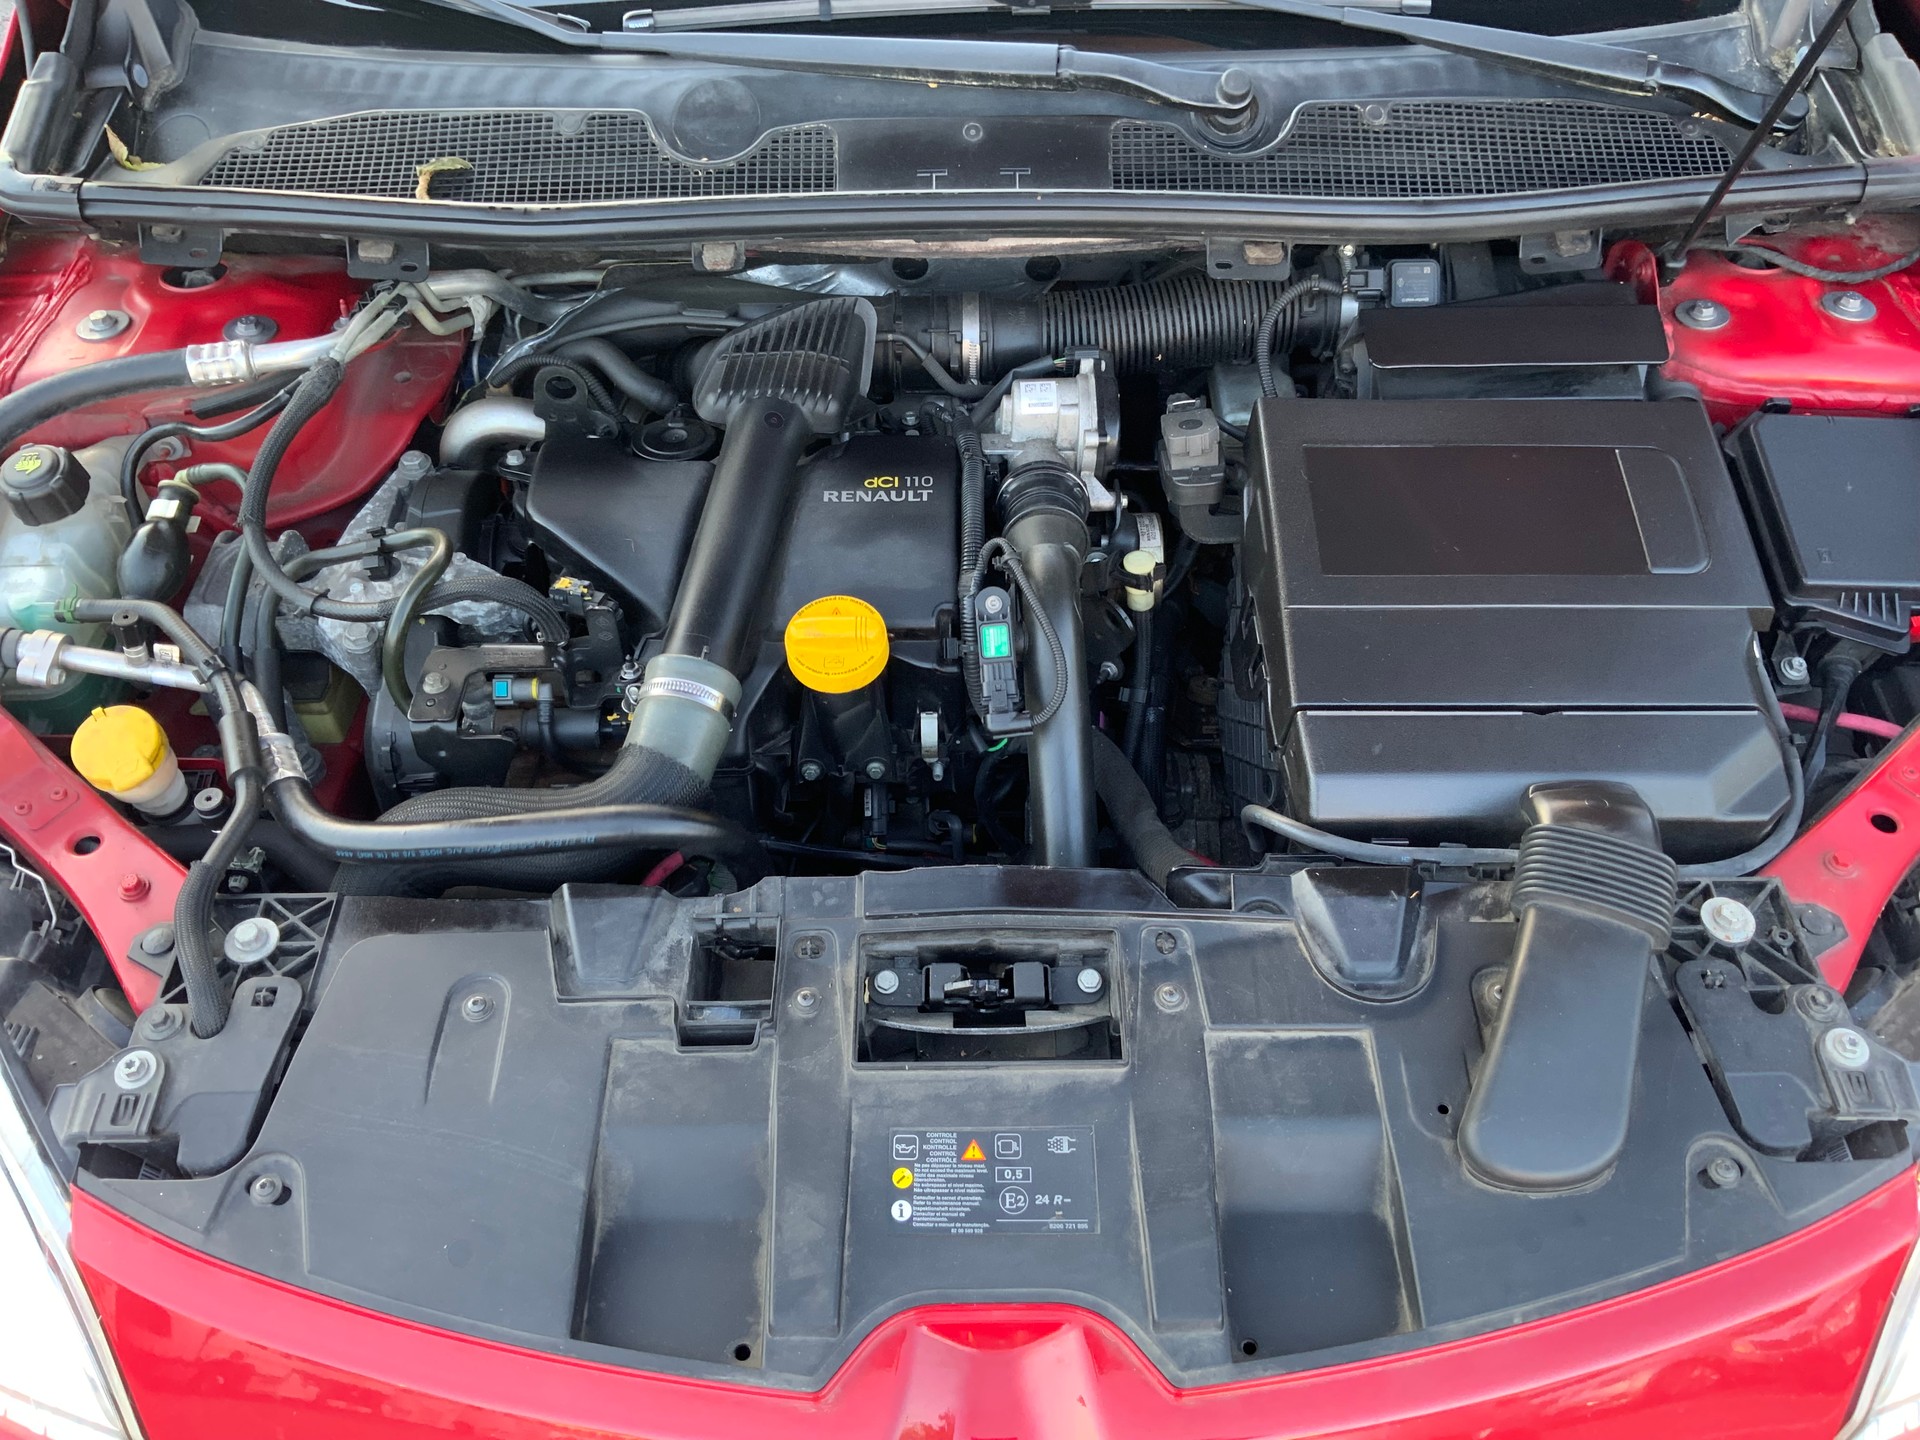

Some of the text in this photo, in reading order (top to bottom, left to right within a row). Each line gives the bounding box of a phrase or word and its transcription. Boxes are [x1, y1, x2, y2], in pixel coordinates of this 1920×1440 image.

[905, 476, 933, 487] 110
[823, 490, 933, 502] RENAULT
[815, 597, 836, 605] exceed
[1004, 1170, 1022, 1180] 0,5
[1004, 1193, 1025, 1208] E2
[1035, 1195, 1049, 1204] 24
